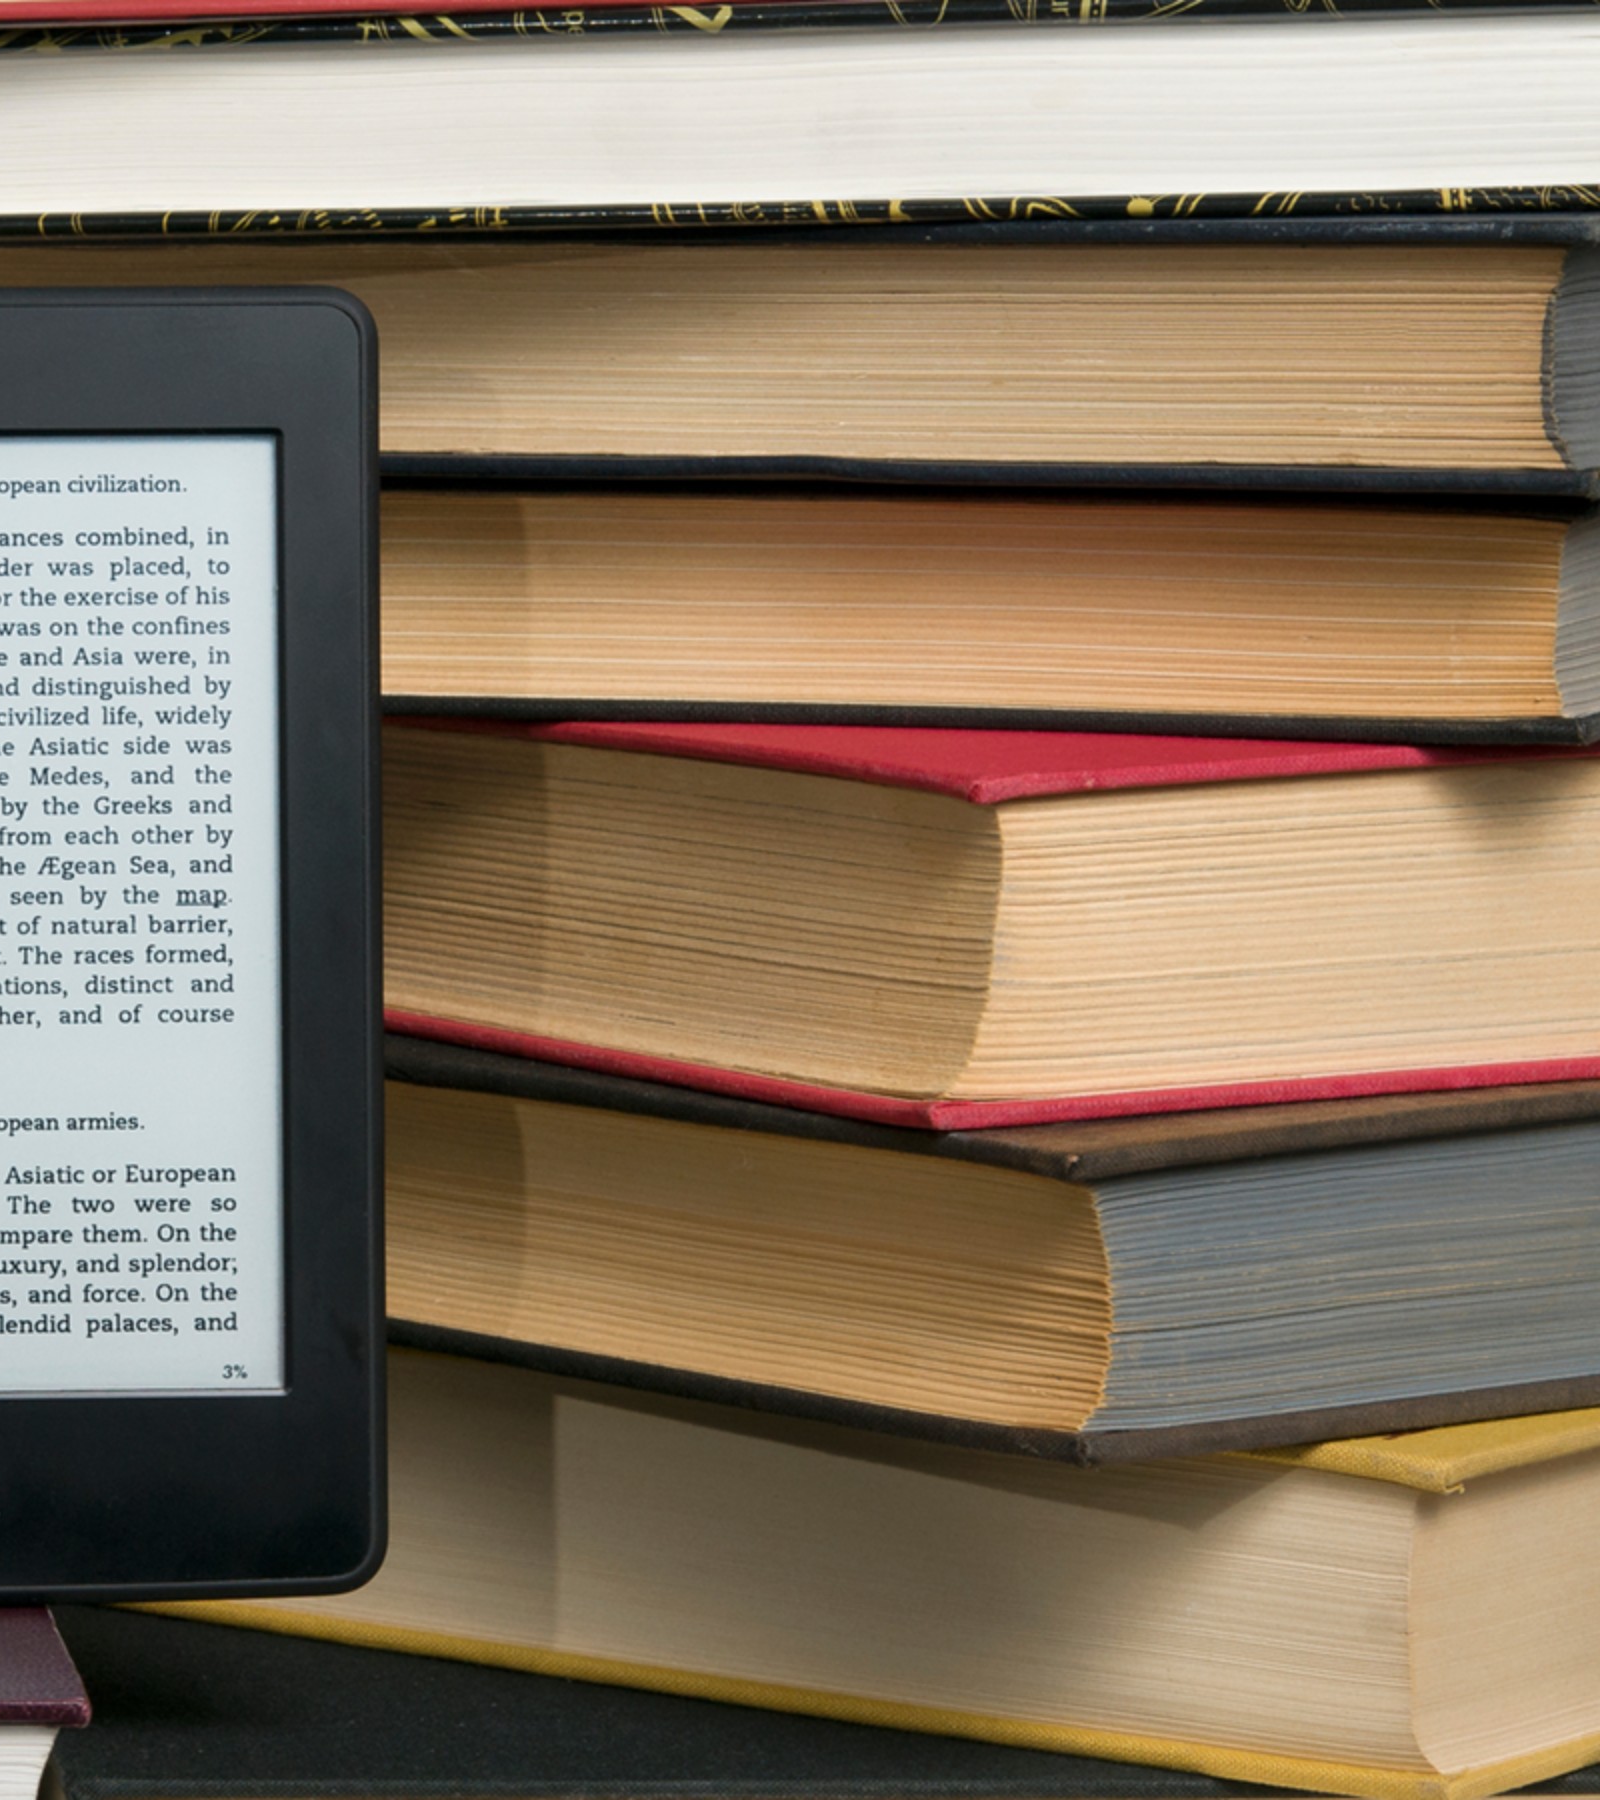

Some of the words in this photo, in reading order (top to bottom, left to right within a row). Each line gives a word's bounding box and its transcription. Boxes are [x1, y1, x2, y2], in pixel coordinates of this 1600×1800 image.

[67, 474, 187, 493] civilization.
[75, 526, 195, 548] combined,
[207, 528, 230, 545] in
[19, 587, 57, 606] the
[63, 588, 159, 606] exercise
[165, 586, 190, 605] of
[195, 586, 231, 604] his
[19, 646, 63, 666] and
[72, 648, 124, 665] Asia
[133, 651, 197, 668] were,
[208, 646, 230, 664] in
[31, 676, 191, 700] distinguished
[203, 675, 232, 699] by
[28, 737, 109, 756] Asiatic
[123, 735, 171, 754] side
[185, 740, 233, 754] was
[0, 796, 29, 821] by
[42, 796, 80, 815] the
[93, 795, 173, 814] Greeks
[188, 794, 233, 814] and
[37, 856, 117, 880] Ægean
[129, 856, 176, 877] Sea,
[189, 854, 233, 873] and
[16, 916, 42, 935] of
[51, 914, 137, 934] natural
[147, 914, 233, 936] barrier,
[17, 946, 63, 965] The
[73, 950, 135, 964] races
[145, 944, 234, 966] formed,
[58, 1004, 103, 1024] and
[118, 1004, 143, 1023] of
[157, 1009, 235, 1023] course
[66, 1112, 145, 1130] armies.
[4, 1166, 85, 1184] Asiatic
[91, 1170, 117, 1183] or
[125, 1164, 237, 1188] European
[82, 1224, 148, 1243] them.
[156, 1224, 191, 1242] On
[199, 1222, 237, 1242] the
[76, 1253, 121, 1273] and
[128, 1252, 238, 1278] splendor;
[27, 1284, 73, 1304] and
[82, 1284, 146, 1303] force.
[155, 1284, 190, 1302] On
[200, 1282, 238, 1301] the
[85, 1313, 179, 1338] palaces,
[193, 1312, 239, 1331] and
[222, 1364, 249, 1379] 3%
